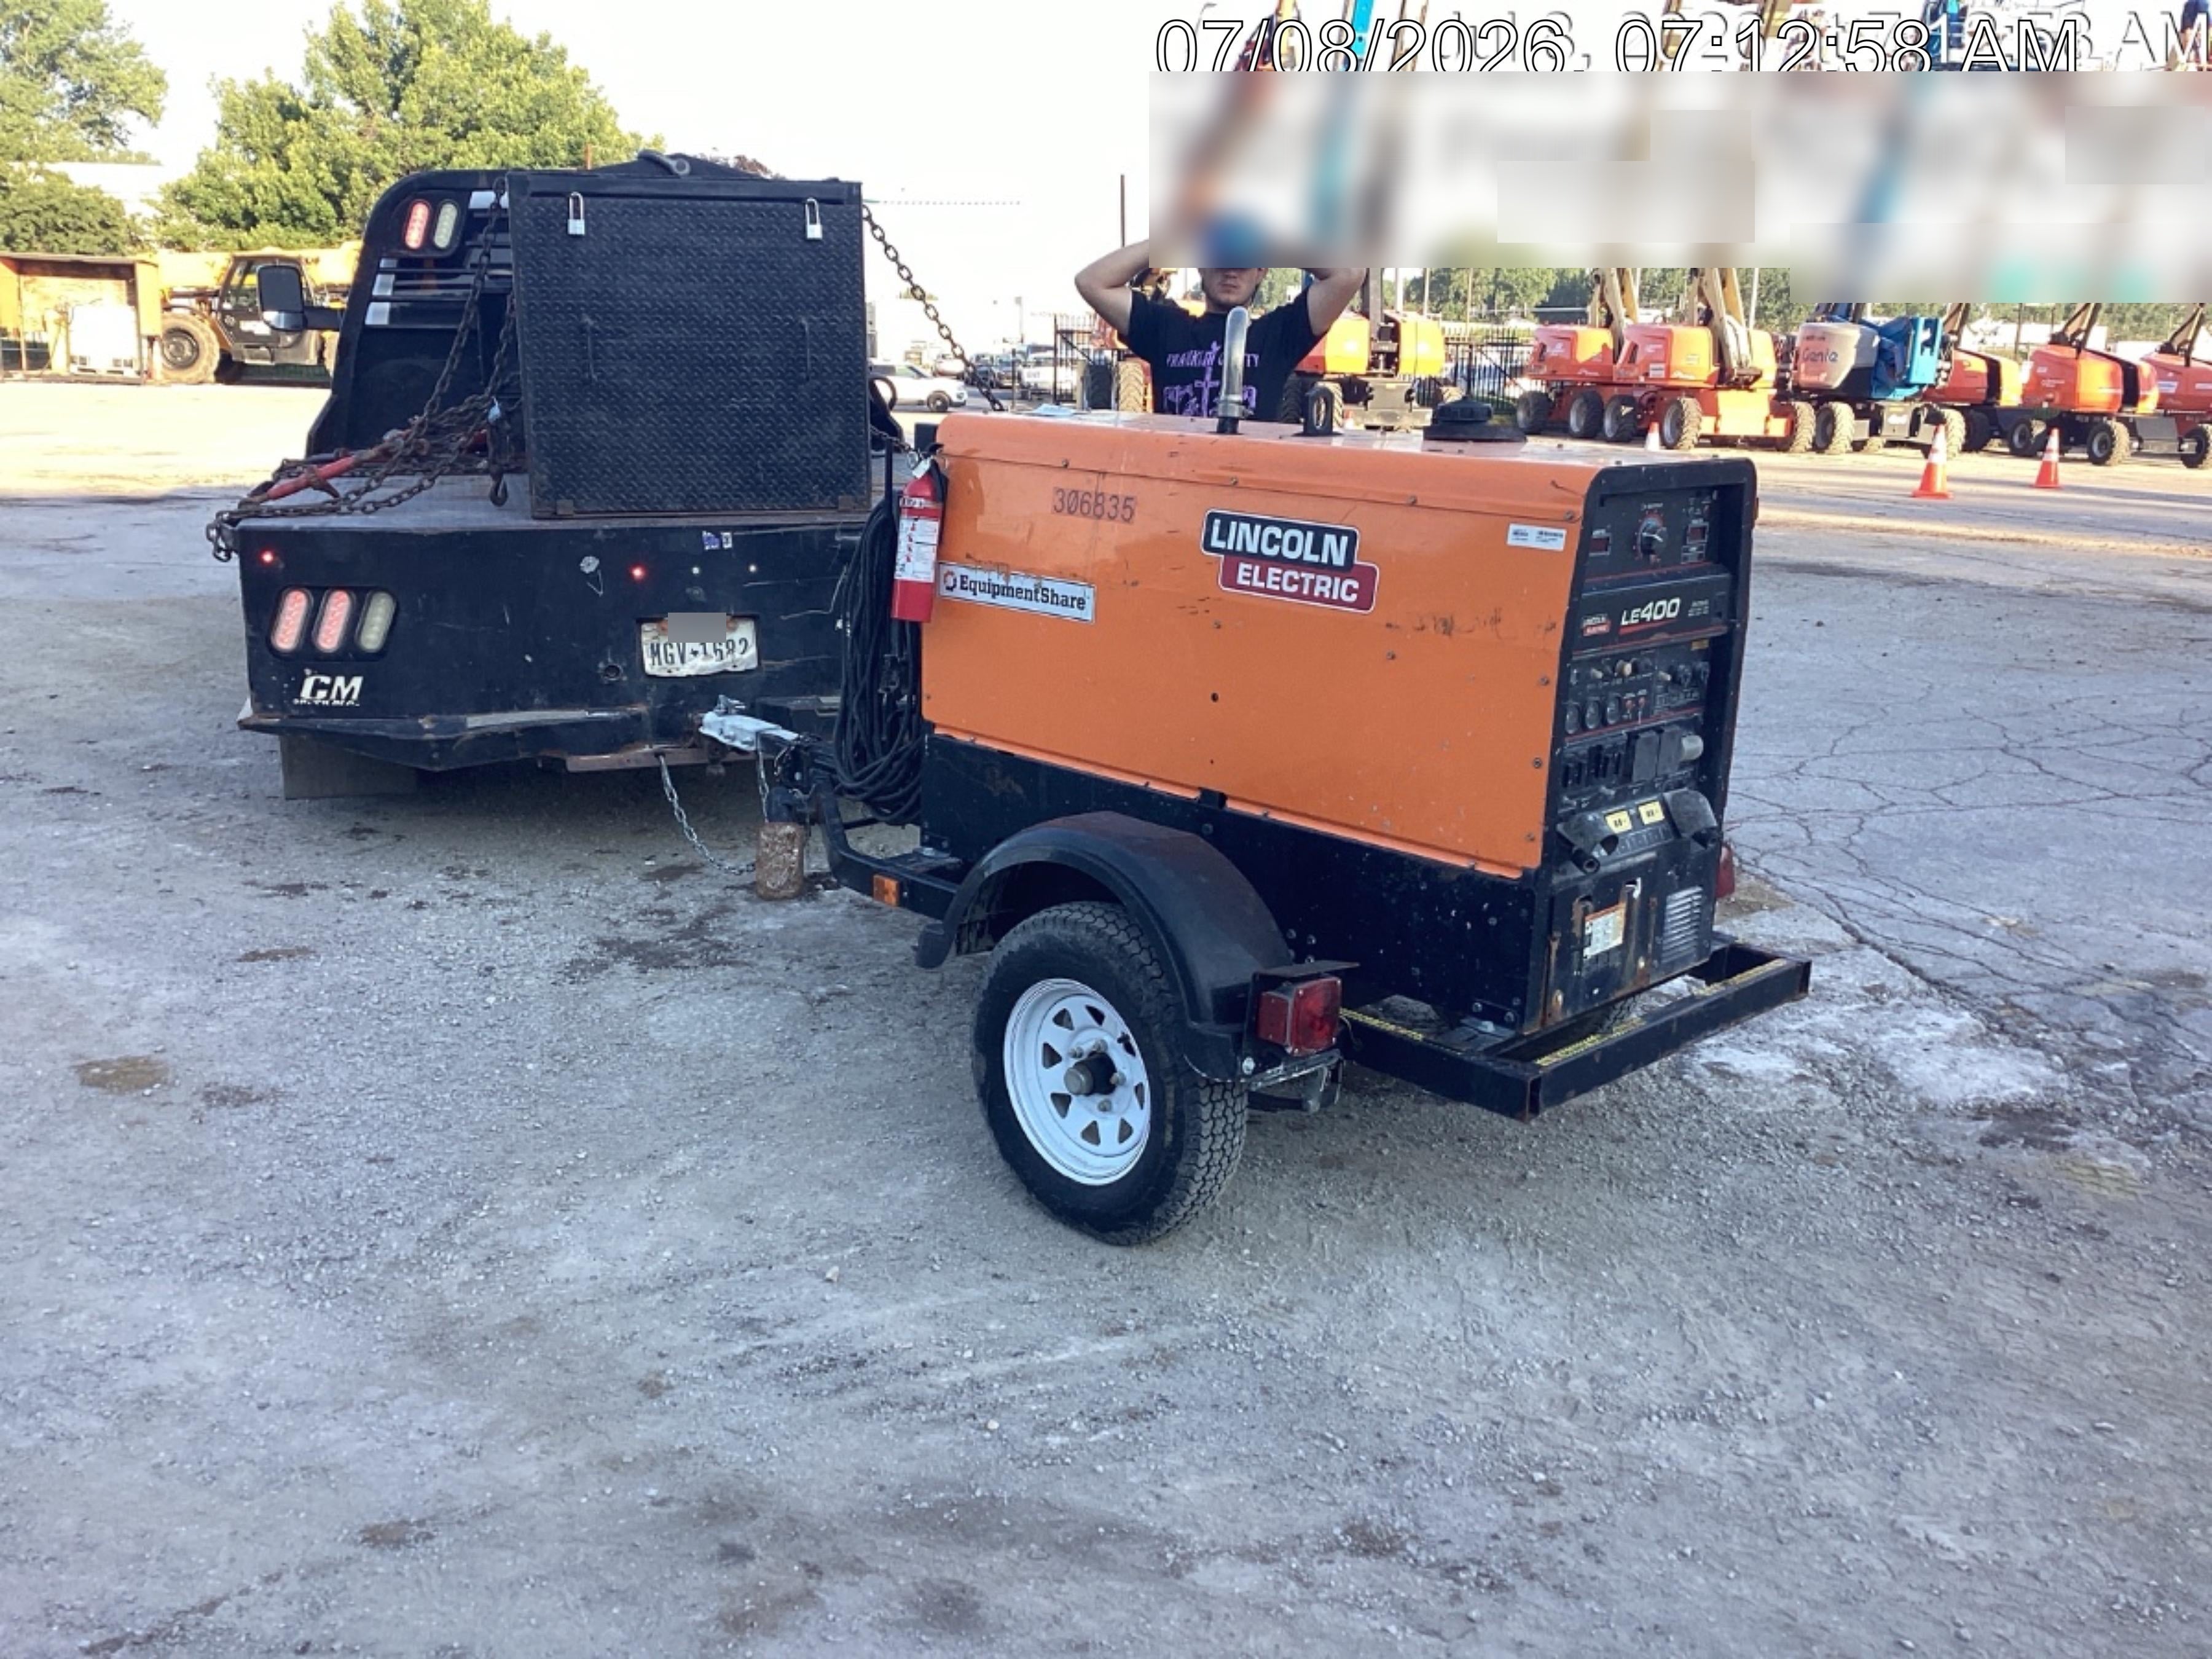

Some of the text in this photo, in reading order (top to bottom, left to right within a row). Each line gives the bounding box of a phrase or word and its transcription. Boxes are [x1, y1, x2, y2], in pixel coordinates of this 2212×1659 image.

[1053, 488, 1135, 522] 306835
[1209, 519, 1349, 567] LINCOLN
[960, 574, 1086, 611] EquipmentShare
[1236, 562, 1360, 603] ELECTRIC
[1619, 597, 1681, 626] LE400
